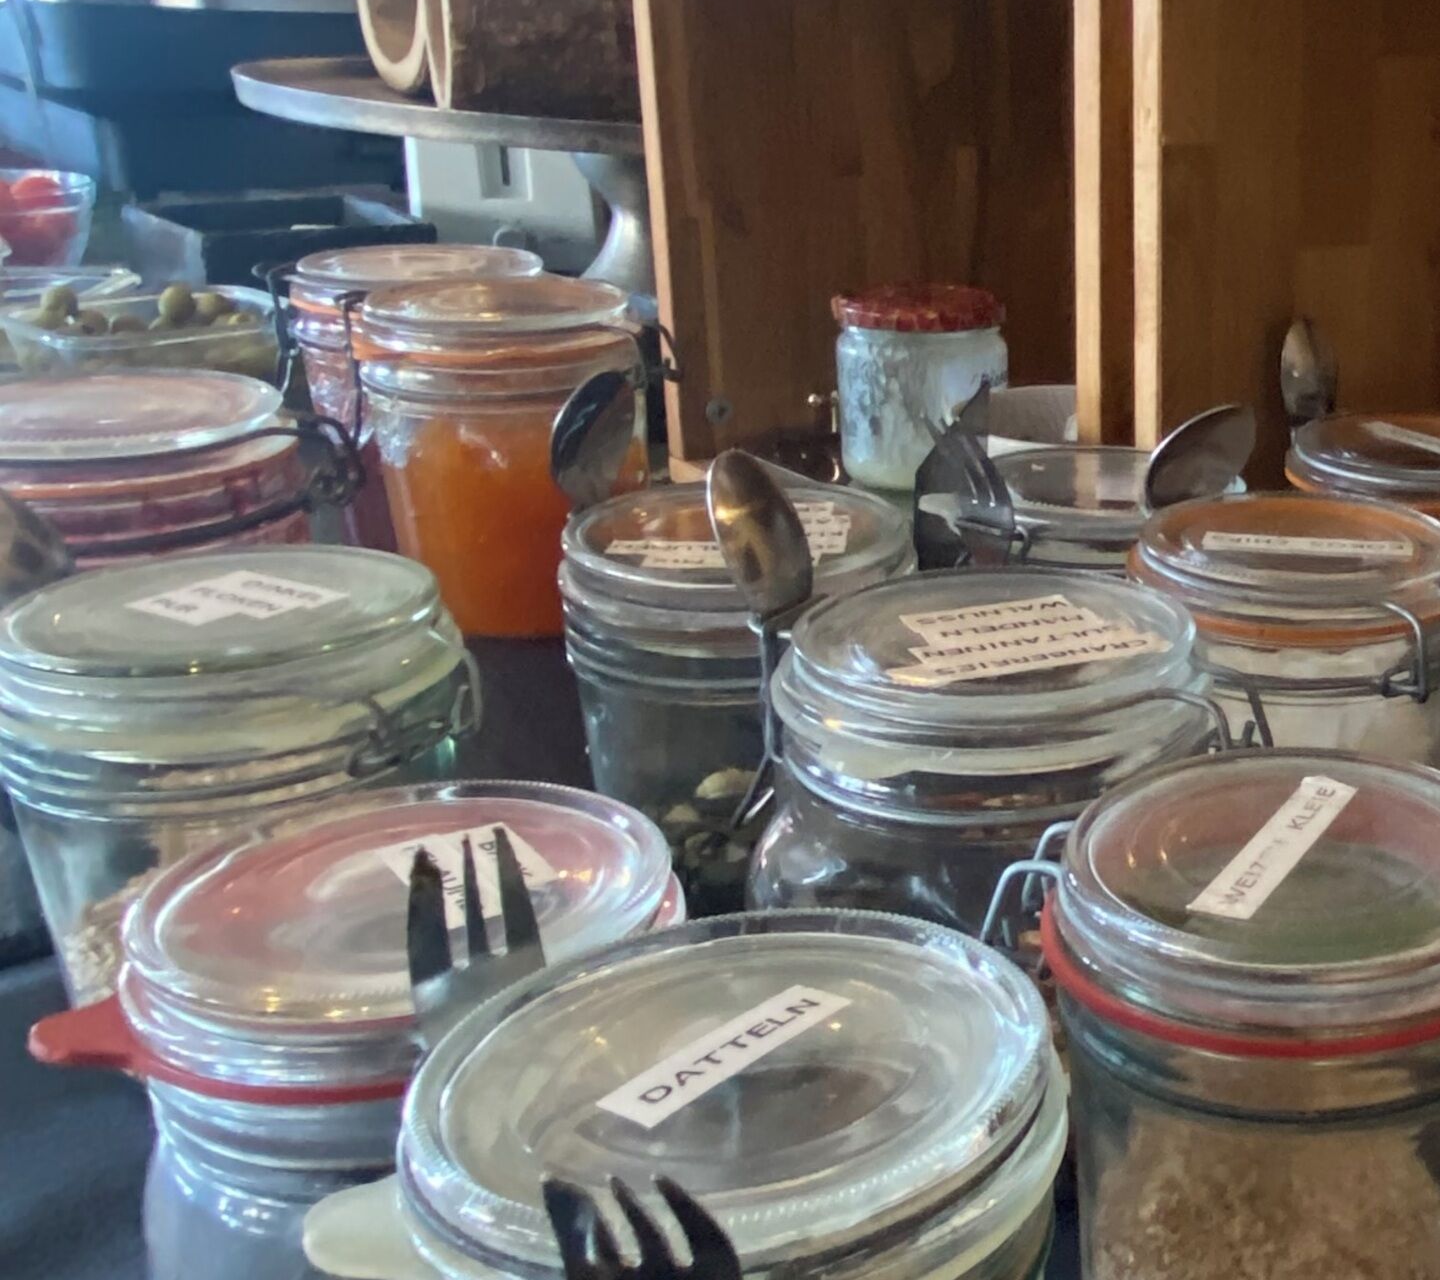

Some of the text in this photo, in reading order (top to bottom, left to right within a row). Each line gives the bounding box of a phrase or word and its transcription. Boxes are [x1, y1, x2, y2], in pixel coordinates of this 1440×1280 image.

[915, 600, 1069, 625] WALNUSS
[939, 613, 1084, 639] MANDELN
[922, 623, 1122, 659] SULTANINEN
[933, 638, 1149, 675] CRANBERRIES
[1286, 785, 1337, 831] KLEIE
[637, 997, 822, 1105] DATTELN
